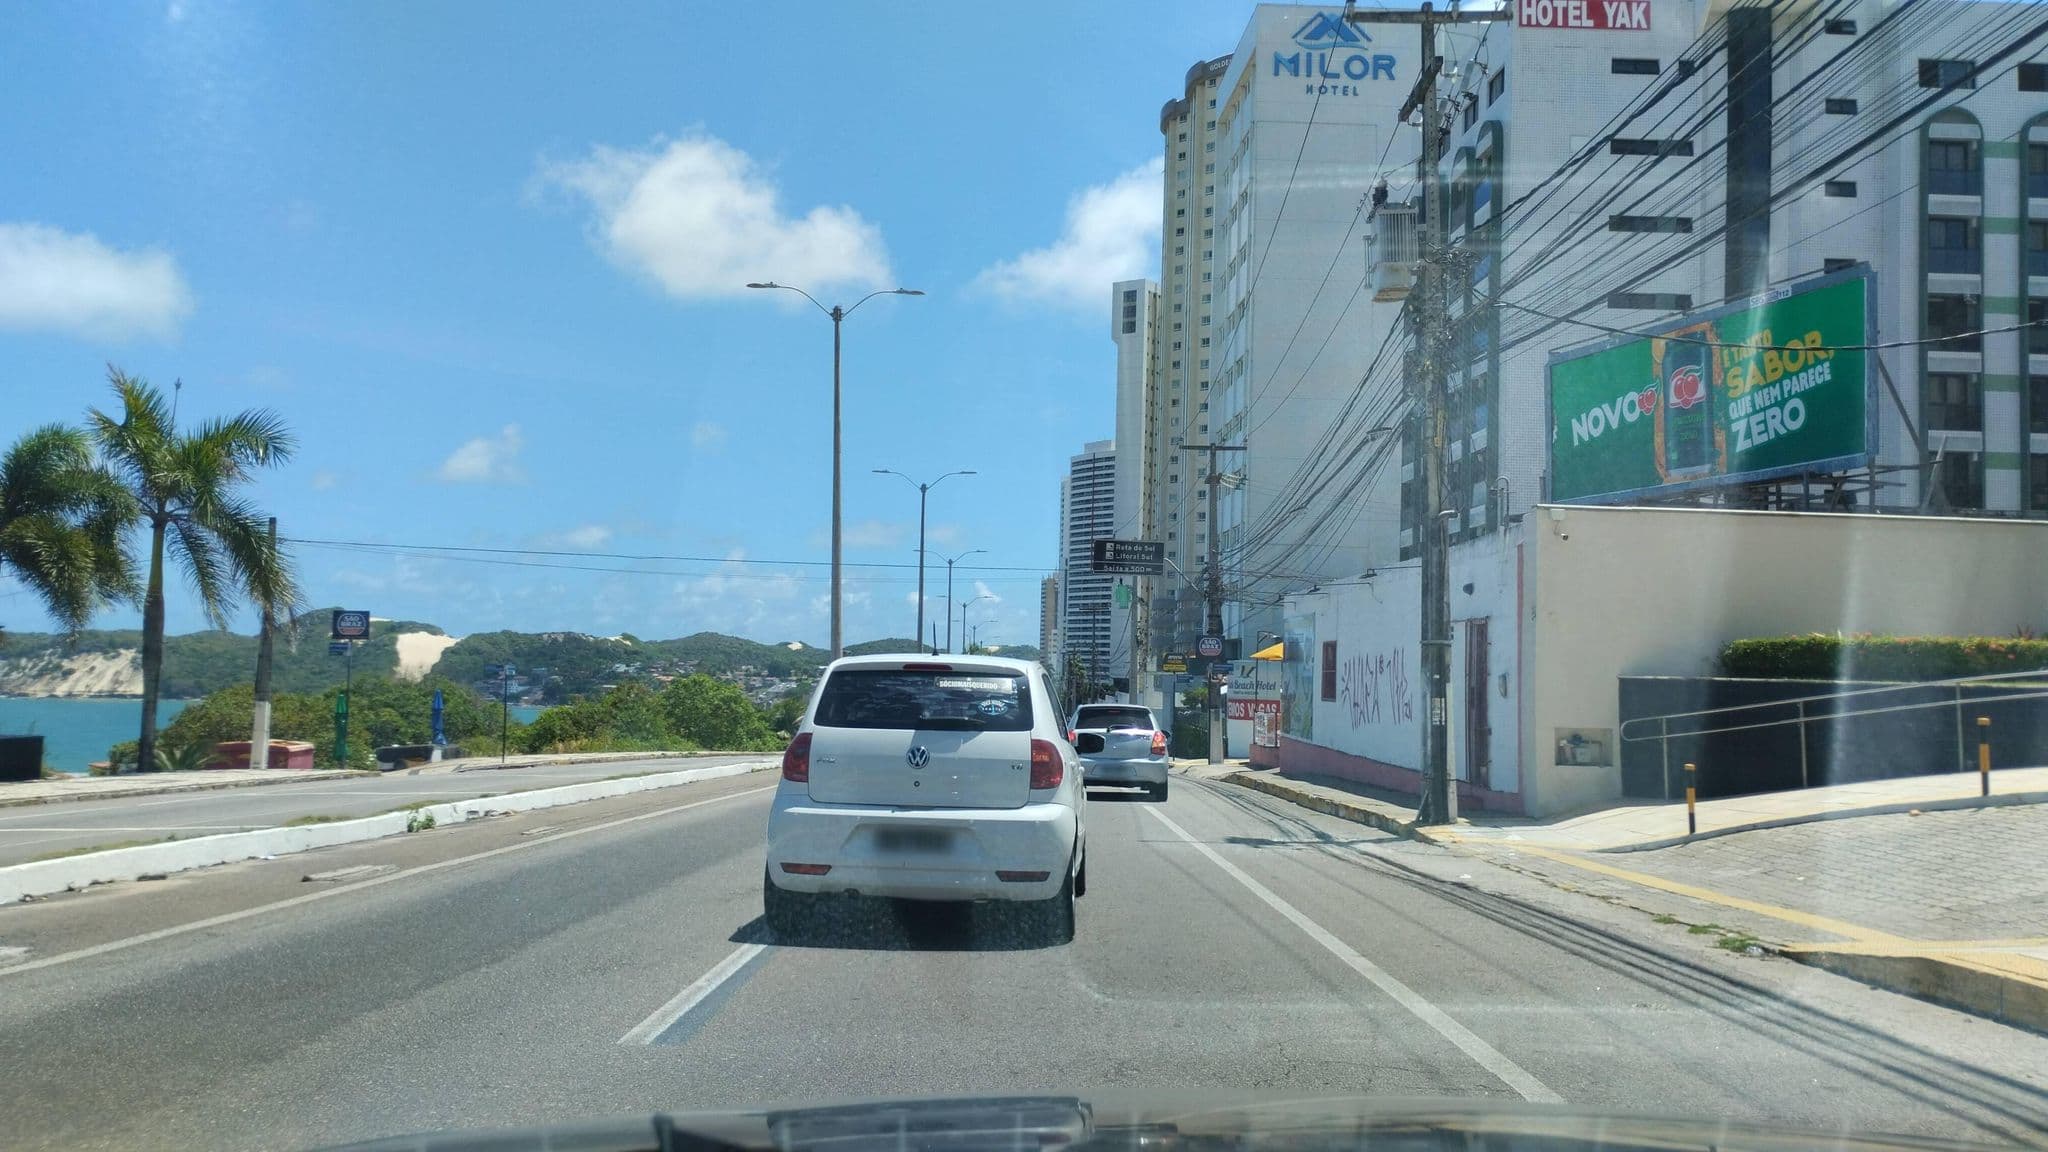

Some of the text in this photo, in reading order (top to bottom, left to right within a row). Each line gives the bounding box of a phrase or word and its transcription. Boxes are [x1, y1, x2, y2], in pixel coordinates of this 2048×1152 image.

[1521, 0, 1648, 29] HOTEL YAK
[1209, 58, 1233, 72] GOLDE
[1273, 51, 1397, 81] MILOR
[1306, 84, 1360, 97] HOTEL
[1727, 330, 1836, 399] SABOR,
[1728, 395, 1753, 420] QUE
[1754, 383, 1782, 410] NEM
[1782, 361, 1832, 397] PARECE
[1571, 391, 1641, 447] NOVO
[1731, 397, 1807, 453] ZERO
[1228, 702, 1278, 718] EMOS VGAS
